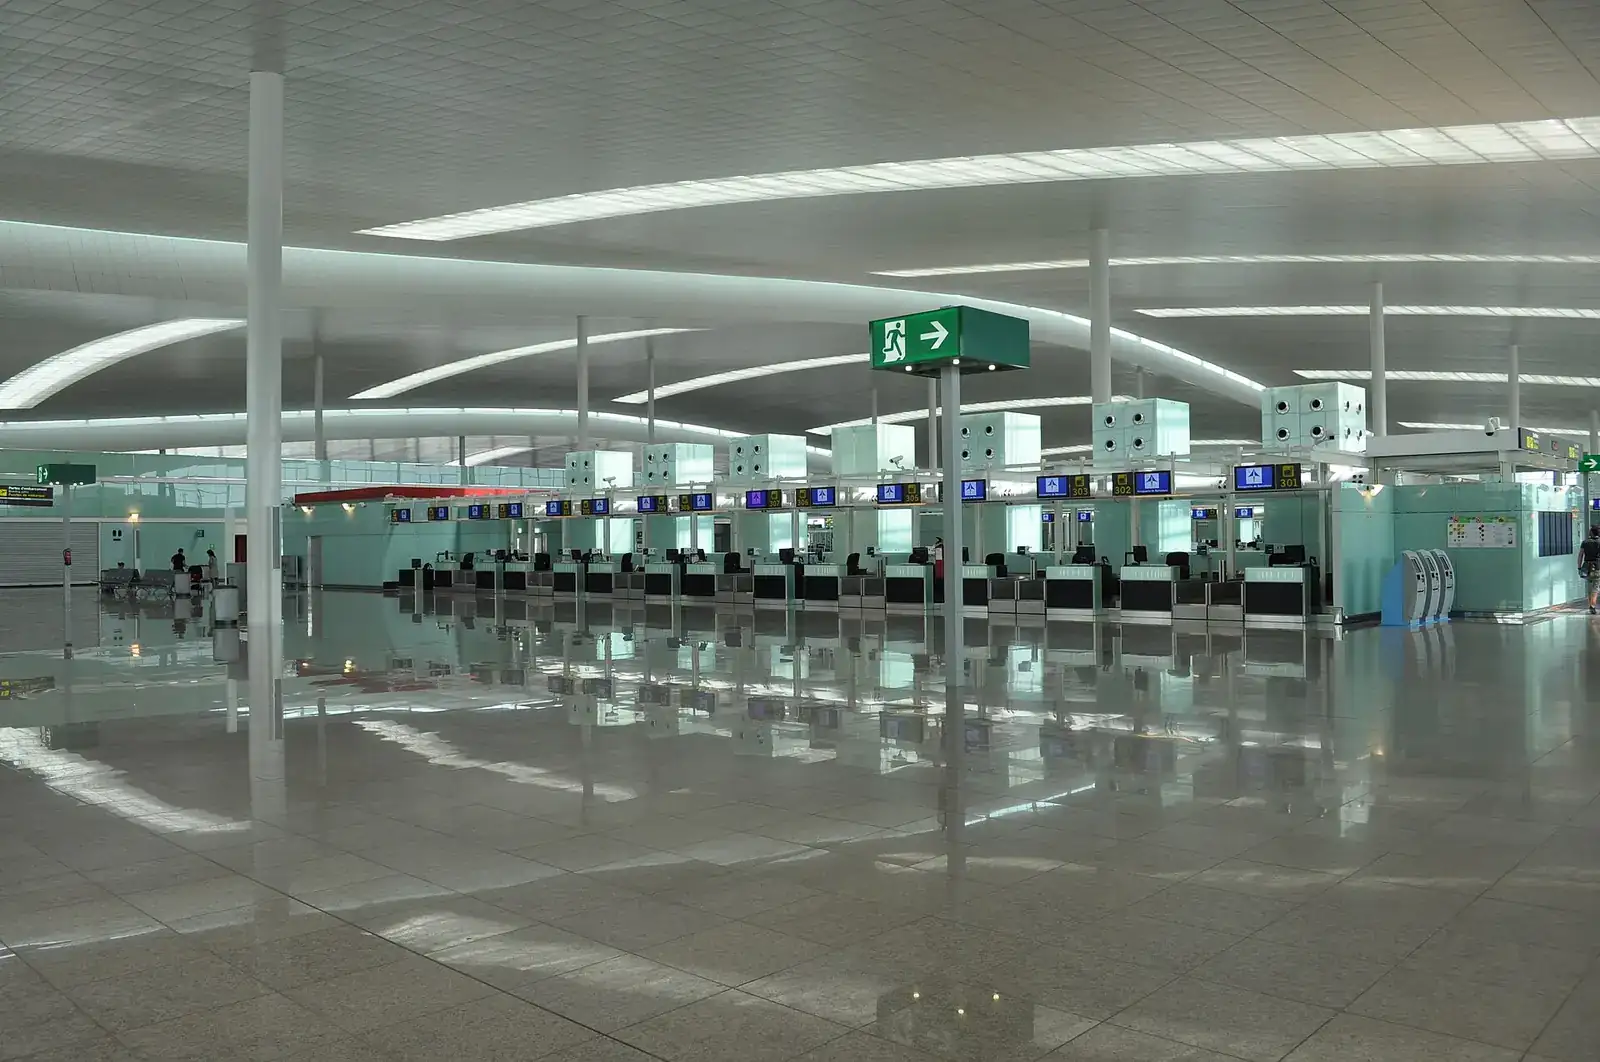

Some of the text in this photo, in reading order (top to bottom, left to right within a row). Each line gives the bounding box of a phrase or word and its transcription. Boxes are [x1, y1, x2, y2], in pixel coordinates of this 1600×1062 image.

[1280, 478, 1298, 487] 301
[1072, 487, 1088, 496] 303
[1114, 485, 1131, 494] 302
